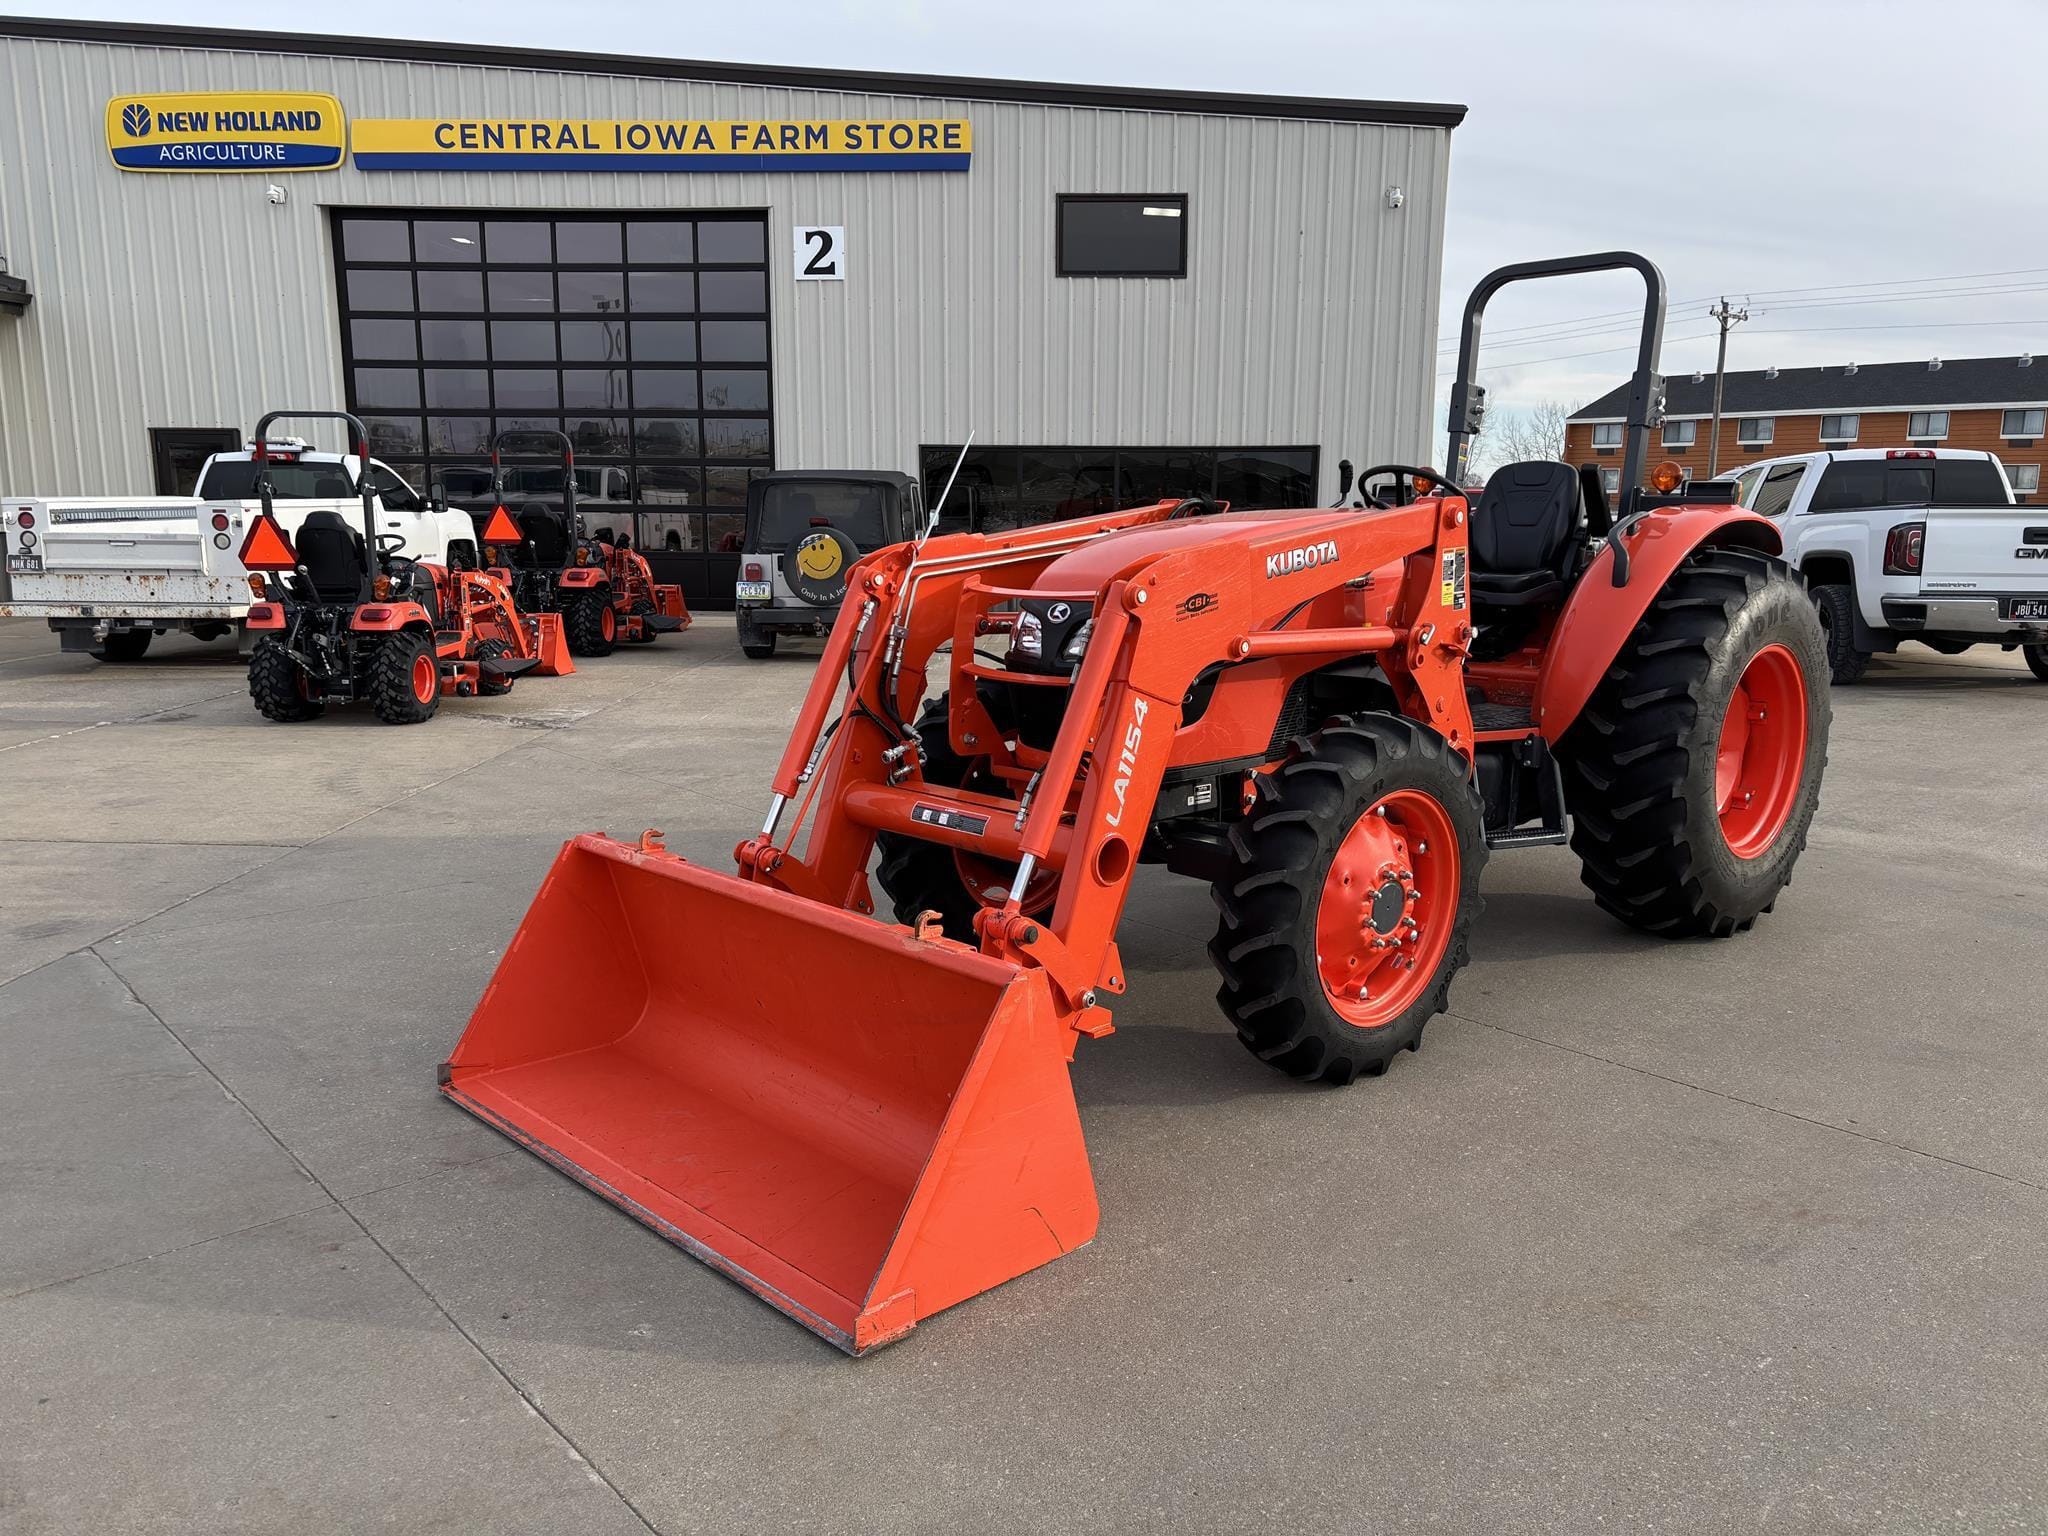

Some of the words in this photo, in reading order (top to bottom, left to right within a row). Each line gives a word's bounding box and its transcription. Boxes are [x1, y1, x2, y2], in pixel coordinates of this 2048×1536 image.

[158, 112, 209, 132] NEW
[215, 111, 321, 132] HOLLAND
[434, 123, 600, 150] CENTRAL
[615, 124, 716, 150] IOWA
[731, 124, 829, 150] FARM
[844, 124, 962, 150] STORE
[159, 145, 286, 161] AGRICULTURE
[803, 230, 836, 276] 2
[1266, 540, 1339, 579] KUBOTA
[801, 587, 818, 601] Only
[830, 592, 836, 600] A
[1188, 595, 1207, 609] CBI
[2015, 604, 2031, 616] JBU
[2033, 604, 2047, 616] 541
[1105, 697, 1149, 828] LA1154
